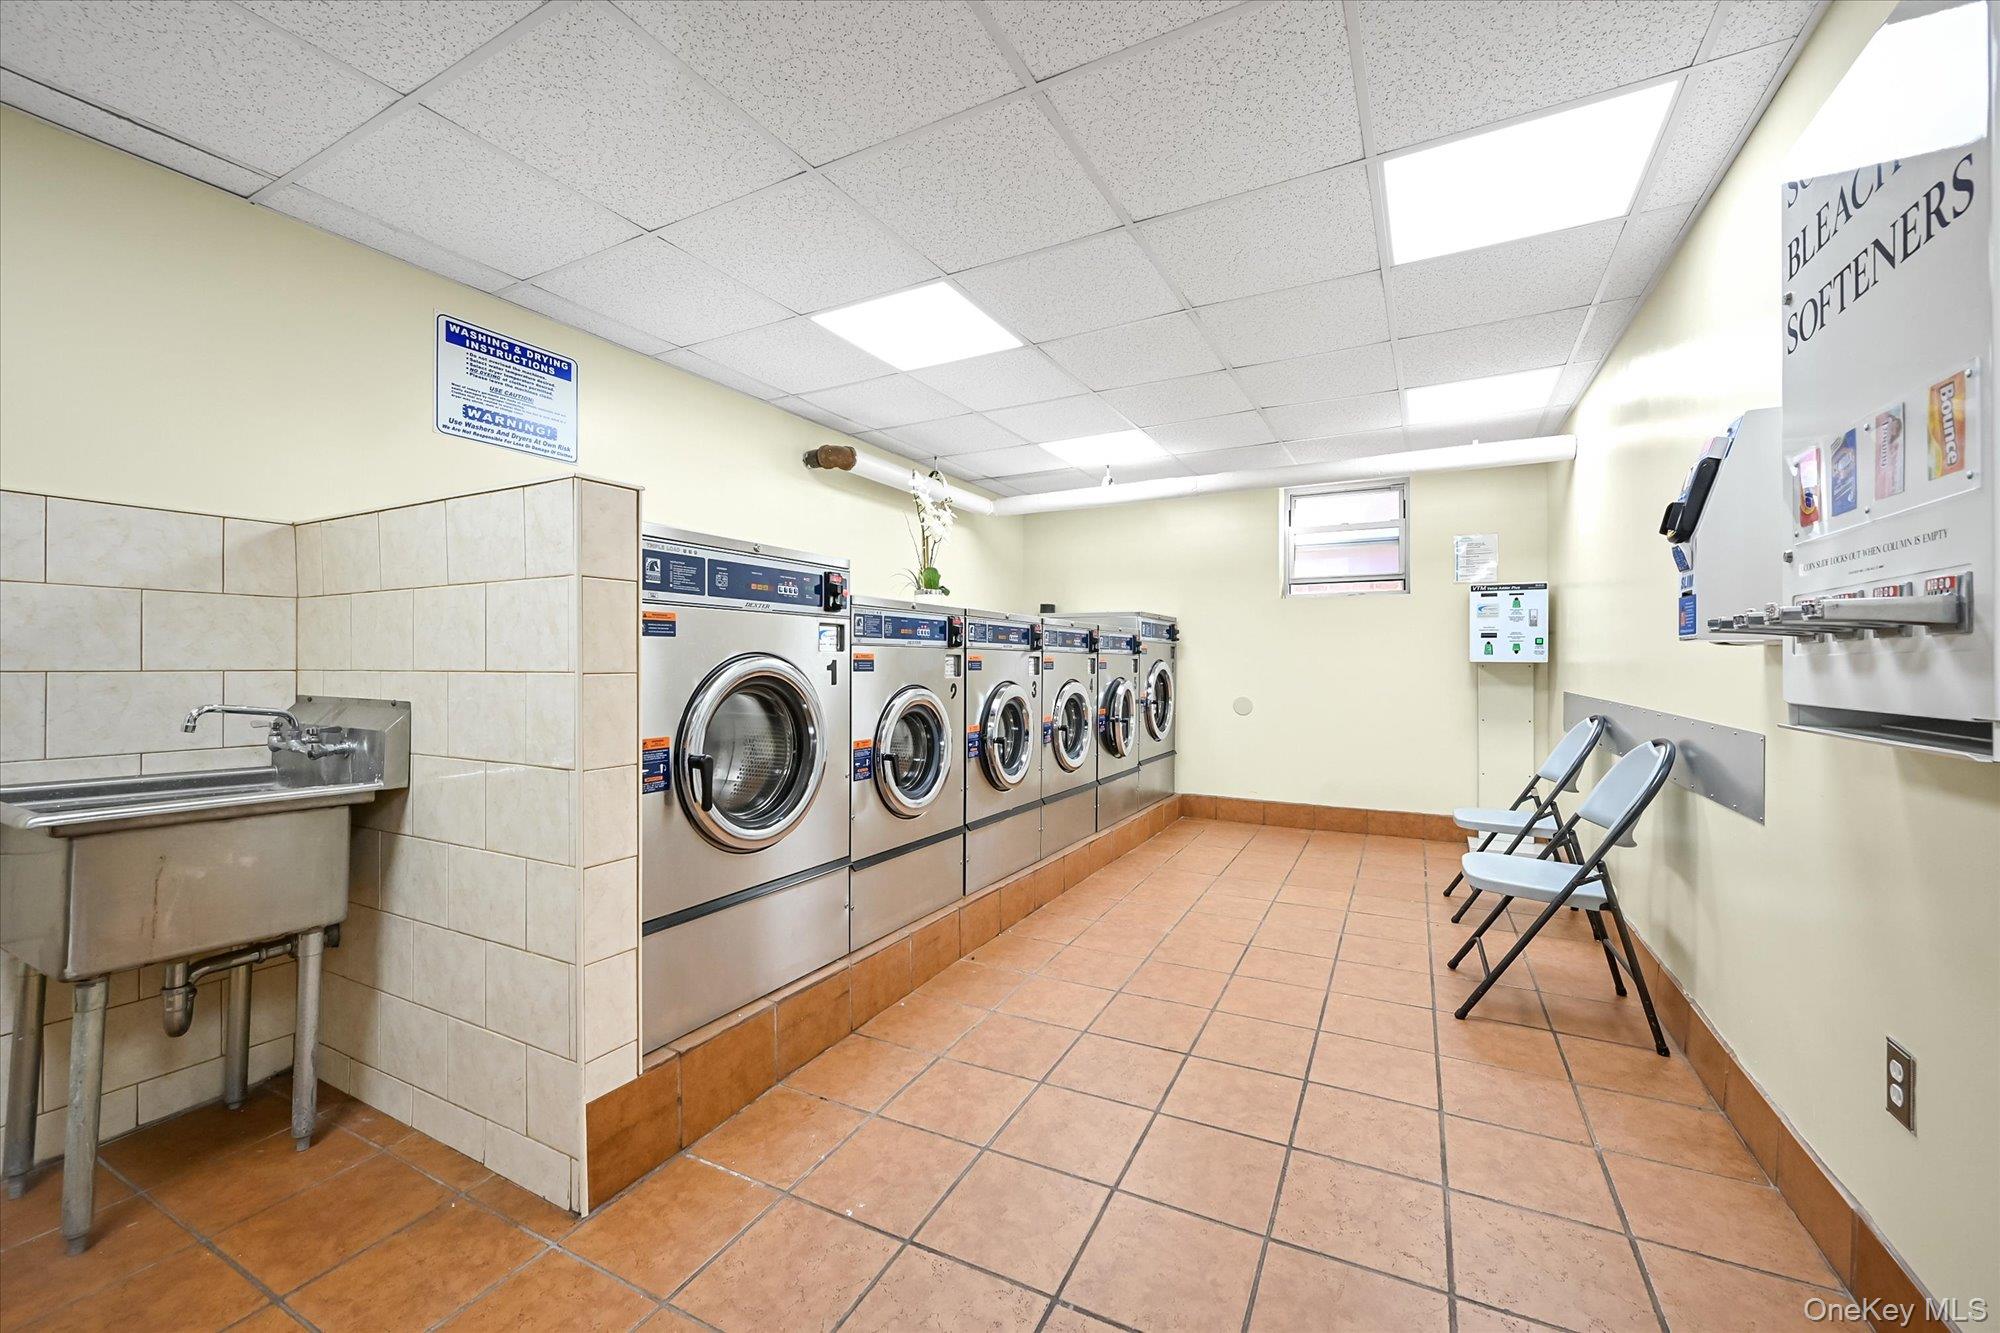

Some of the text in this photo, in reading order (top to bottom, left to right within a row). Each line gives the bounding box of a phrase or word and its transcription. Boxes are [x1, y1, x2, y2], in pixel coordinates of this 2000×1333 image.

[1788, 153, 1974, 355] SOFTENERS
[449, 322, 568, 370] WASHING & DRYING
[465, 338, 554, 375] INSTRUCTIONS
[489, 385, 502, 393] USE
[448, 417, 462, 426] Use
[464, 420, 494, 433] Washers
[496, 428, 509, 437] And
[511, 432, 531, 444] Dryers
[542, 440, 556, 449] Own
[557, 444, 570, 452] Risk
[467, 407, 550, 436] WARNING!
[1938, 381, 1958, 468] Bounce
[472, 430, 502, 442] Responsible
[531, 445, 549, 453] Damage
[1830, 554, 1848, 565] LOCKS
[1849, 550, 1861, 560] OUT
[1862, 545, 1881, 557] WHEN
[1882, 538, 1912, 552] COLUMN
[1913, 535, 1921, 545] IS
[1922, 528, 1948, 543] EMPTY
[826, 660, 837, 685] 1
[1031, 680, 1037, 698] 3
